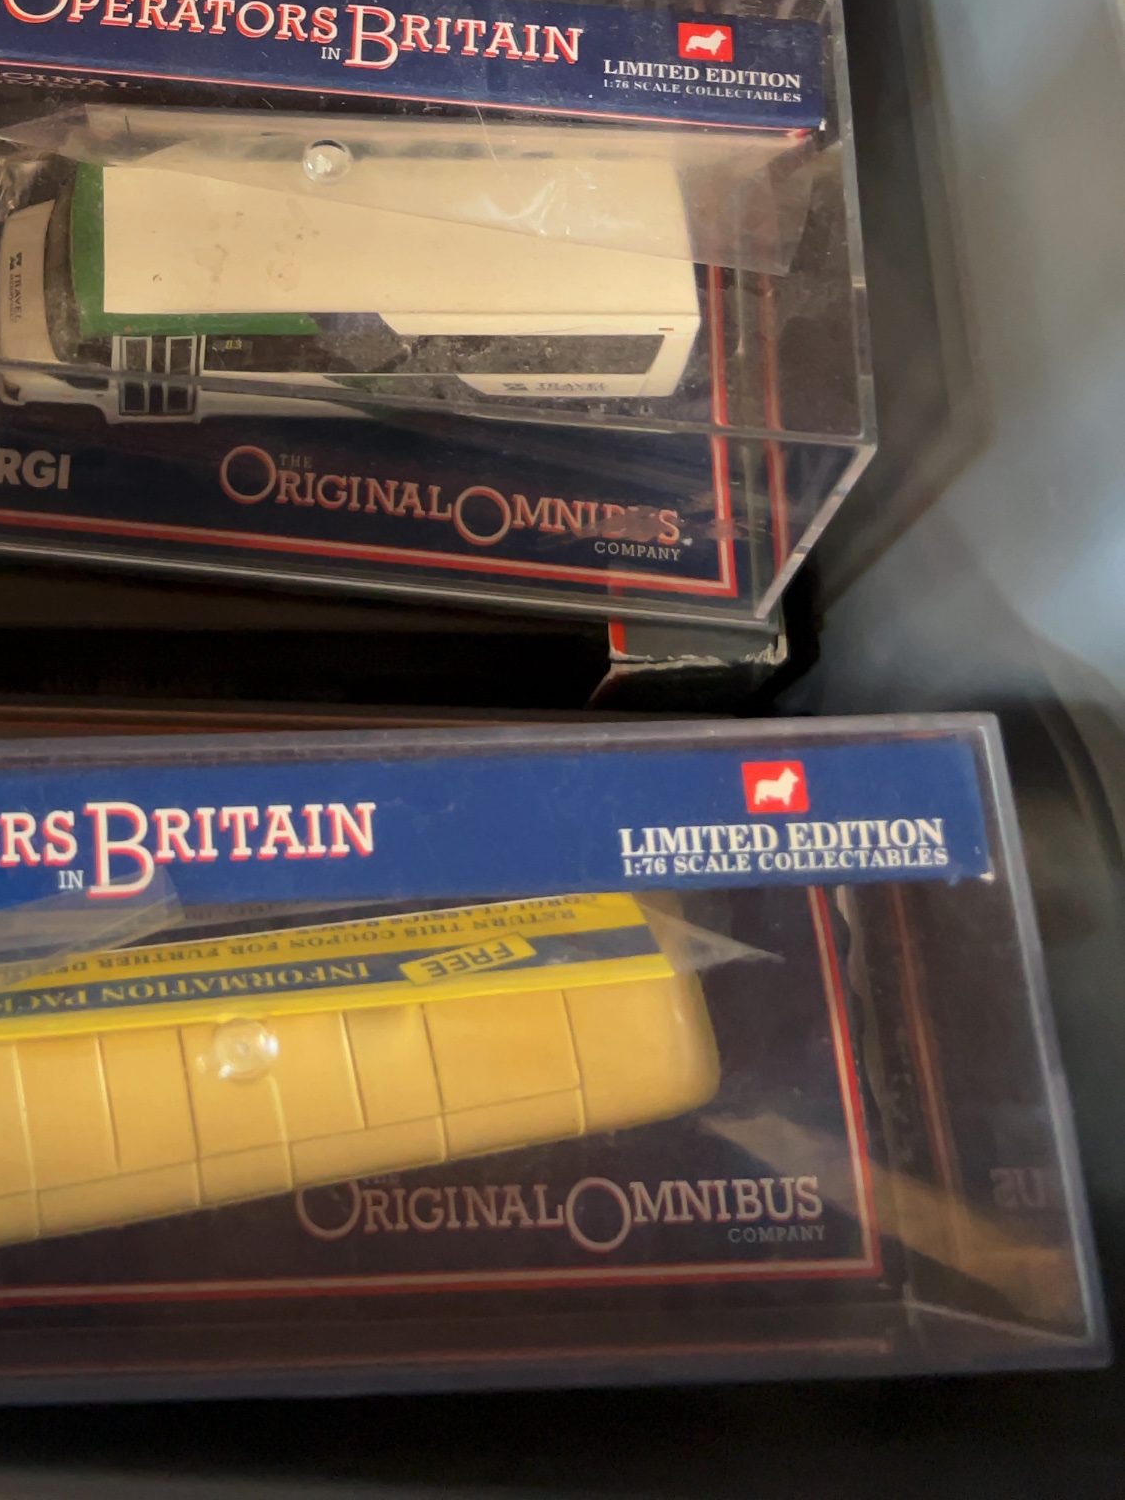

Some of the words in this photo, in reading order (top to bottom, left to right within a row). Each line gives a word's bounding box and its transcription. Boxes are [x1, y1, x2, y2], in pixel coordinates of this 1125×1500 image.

[321, 45, 341, 61] IN
[343, 3, 583, 71] BRITAIN
[603, 59, 699, 82] LIMITED
[705, 67, 802, 89] EDITION
[603, 79, 630, 91] 1:76
[634, 81, 681, 94] SCALE
[685, 85, 802, 103] COLLECTABLES
[279, 453, 313, 469] THE
[219, 445, 455, 521] ORIGINAL
[453, 486, 680, 546] OMNIS
[594, 541, 681, 562] COMPANY
[59, 869, 84, 891] IN
[83, 801, 376, 899] BRITAIN
[618, 824, 778, 858] LIMITED
[785, 817, 946, 851] EDITION
[623, 857, 667, 877] 1:76
[674, 853, 752, 874] SCALE
[758, 847, 949, 871] COLLECTABLES
[404, 923, 462, 938] THIS
[472, 909, 576, 930] RETURN
[229, 941, 279, 956] FOR
[289, 929, 395, 948] COUPON
[99, 944, 220, 970] FURTHER
[419, 940, 516, 978] FREE
[101, 961, 370, 1003] INFORMATION
[565, 1176, 825, 1254] OMNIBUS
[728, 1225, 826, 1244] COMPANY
